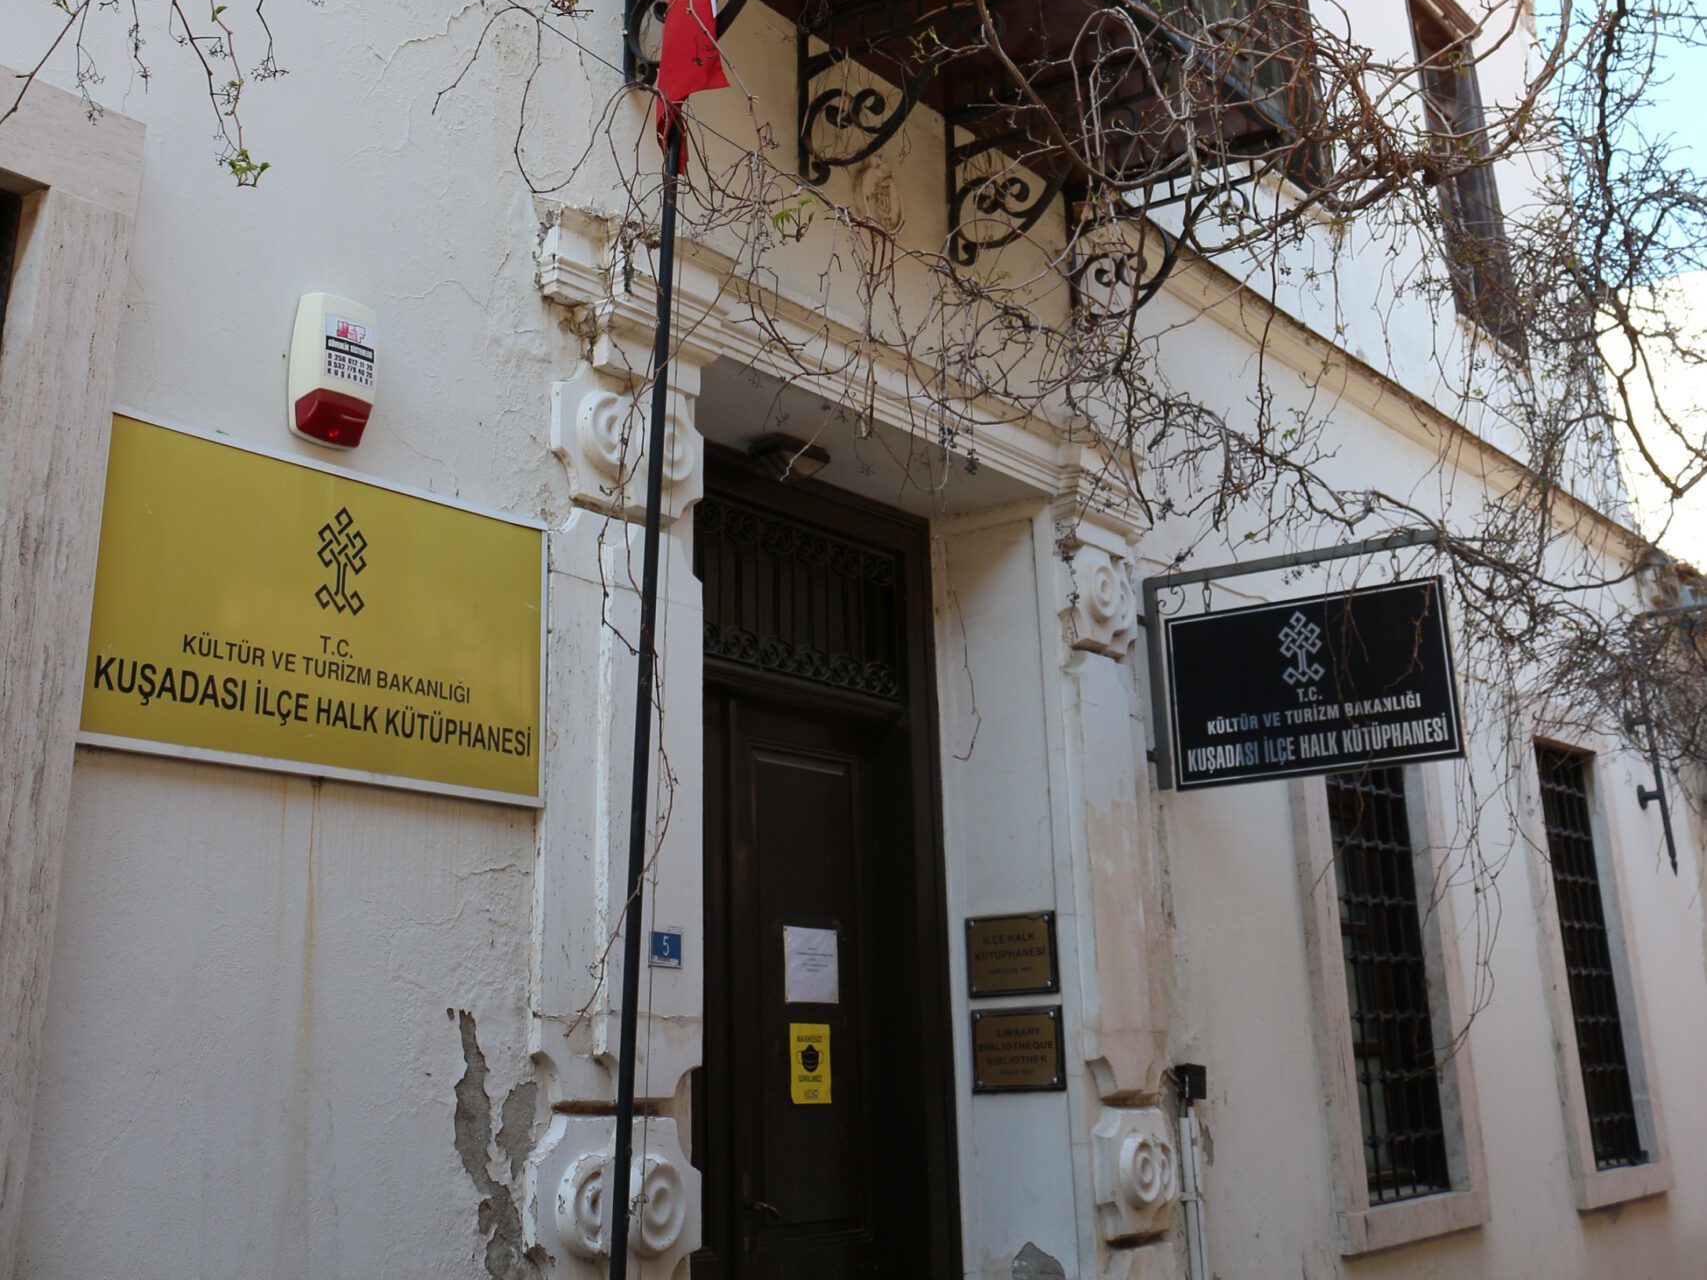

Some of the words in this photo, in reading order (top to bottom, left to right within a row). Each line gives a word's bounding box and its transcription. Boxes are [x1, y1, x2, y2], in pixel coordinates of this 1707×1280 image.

[319, 635, 353, 659] T.C.
[183, 634, 265, 667] KÜLTÜR
[271, 650, 296, 673] VE
[302, 656, 371, 686] TURİZM
[376, 670, 471, 704] BAKANLIĞI
[93, 655, 246, 711] KUŞADASI
[254, 679, 308, 726] İLÇE
[315, 697, 378, 733] HALK
[385, 705, 532, 757] KÜTÜPHANESİ
[1296, 686, 1323, 702] T.C.
[1207, 713, 1259, 735] KÜLTÜR
[1263, 711, 1281, 728] VE
[1285, 702, 1340, 726] TURİZM
[1344, 691, 1421, 717] BAKANLIĞI
[1187, 741, 1260, 774] KUŞADASI
[1264, 735, 1296, 766] İLÇE
[1300, 731, 1338, 759] HALK
[1342, 712, 1449, 753] KÜTÜPHANESİ
[662, 935, 670, 957] 5
[1007, 931, 1035, 943] HALK
[996, 1027, 1041, 1038] LIBRARY
